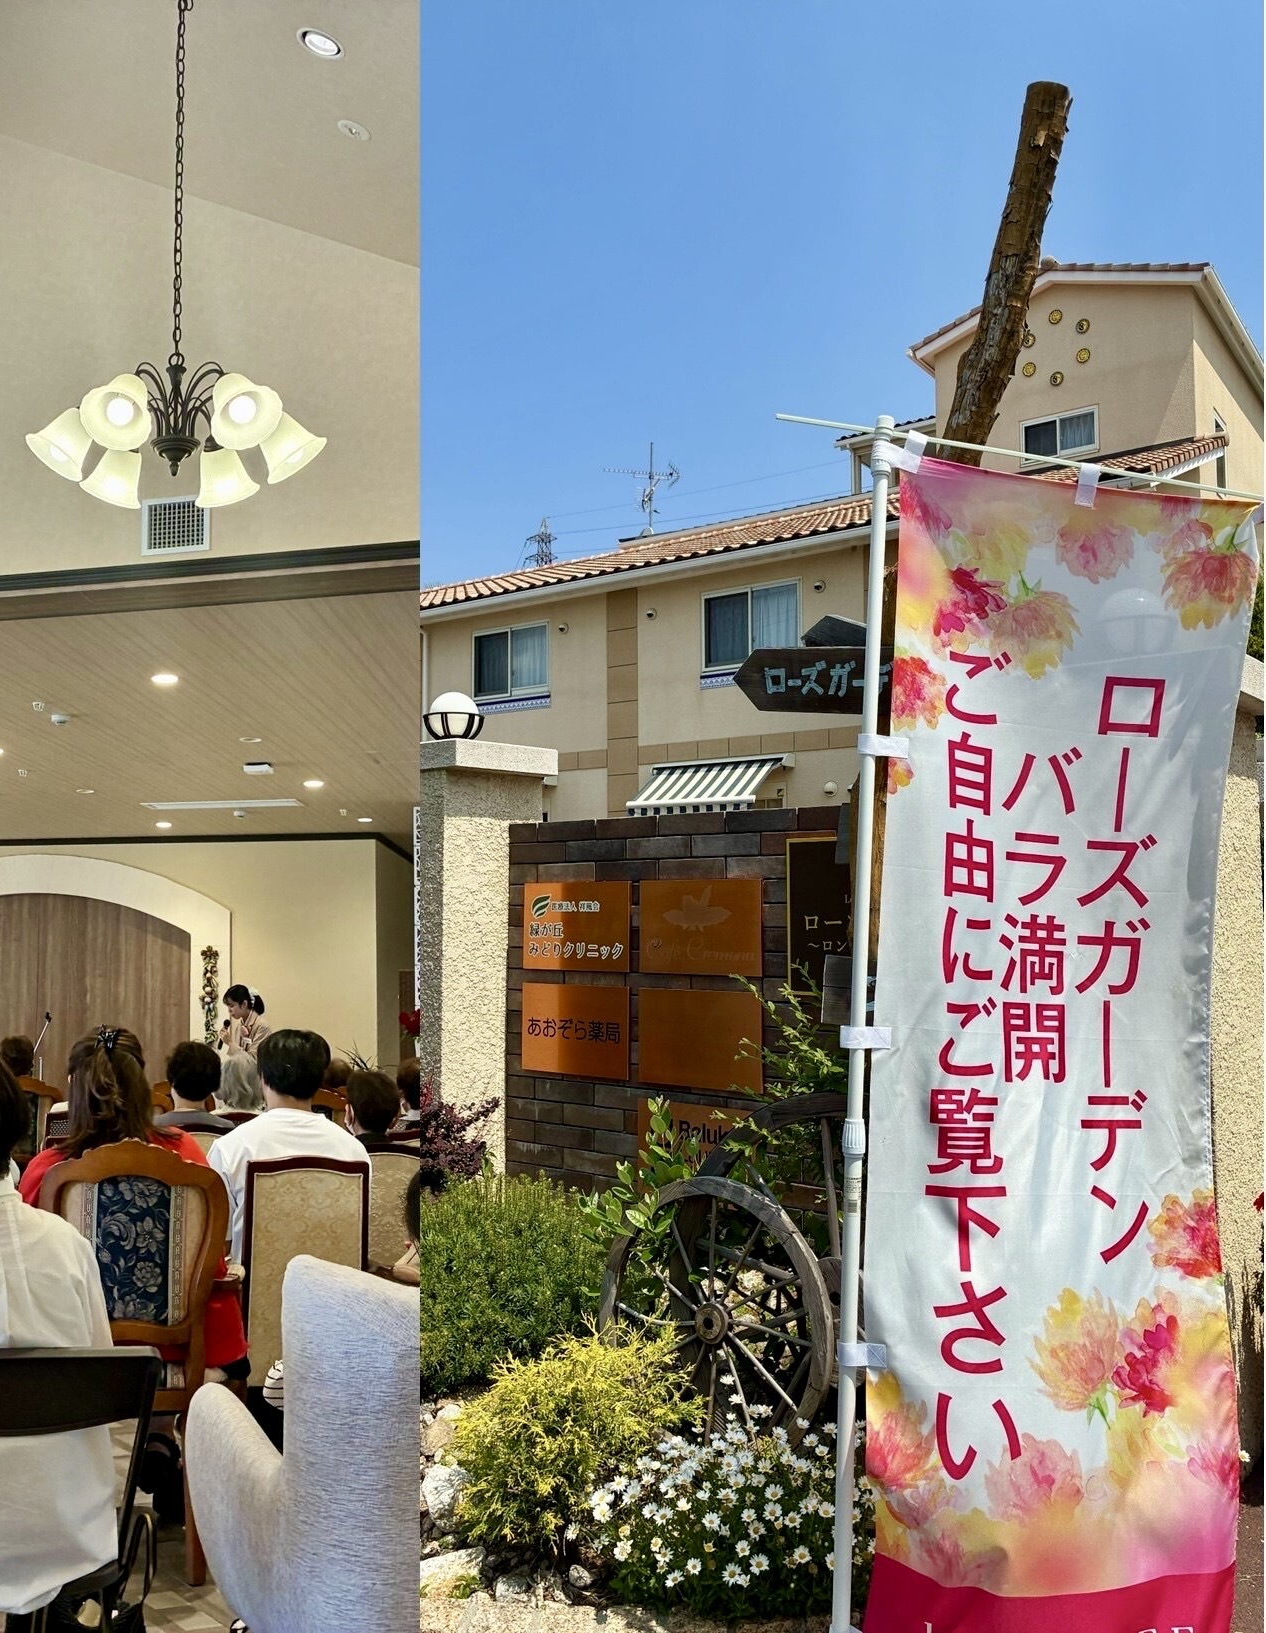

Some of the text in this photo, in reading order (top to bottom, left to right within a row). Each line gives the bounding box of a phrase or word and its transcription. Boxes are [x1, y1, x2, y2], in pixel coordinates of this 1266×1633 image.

[528, 941, 623, 959] みどりクリニック
[529, 922, 564, 938] 緑が丘
[1000, 746, 1083, 1084] バラ満開
[1075, 676, 1167, 1264] ローズガーデン
[527, 1017, 621, 1044] あおぞら薬局
[925, 650, 1024, 1480] ご自由にご覧下さい
